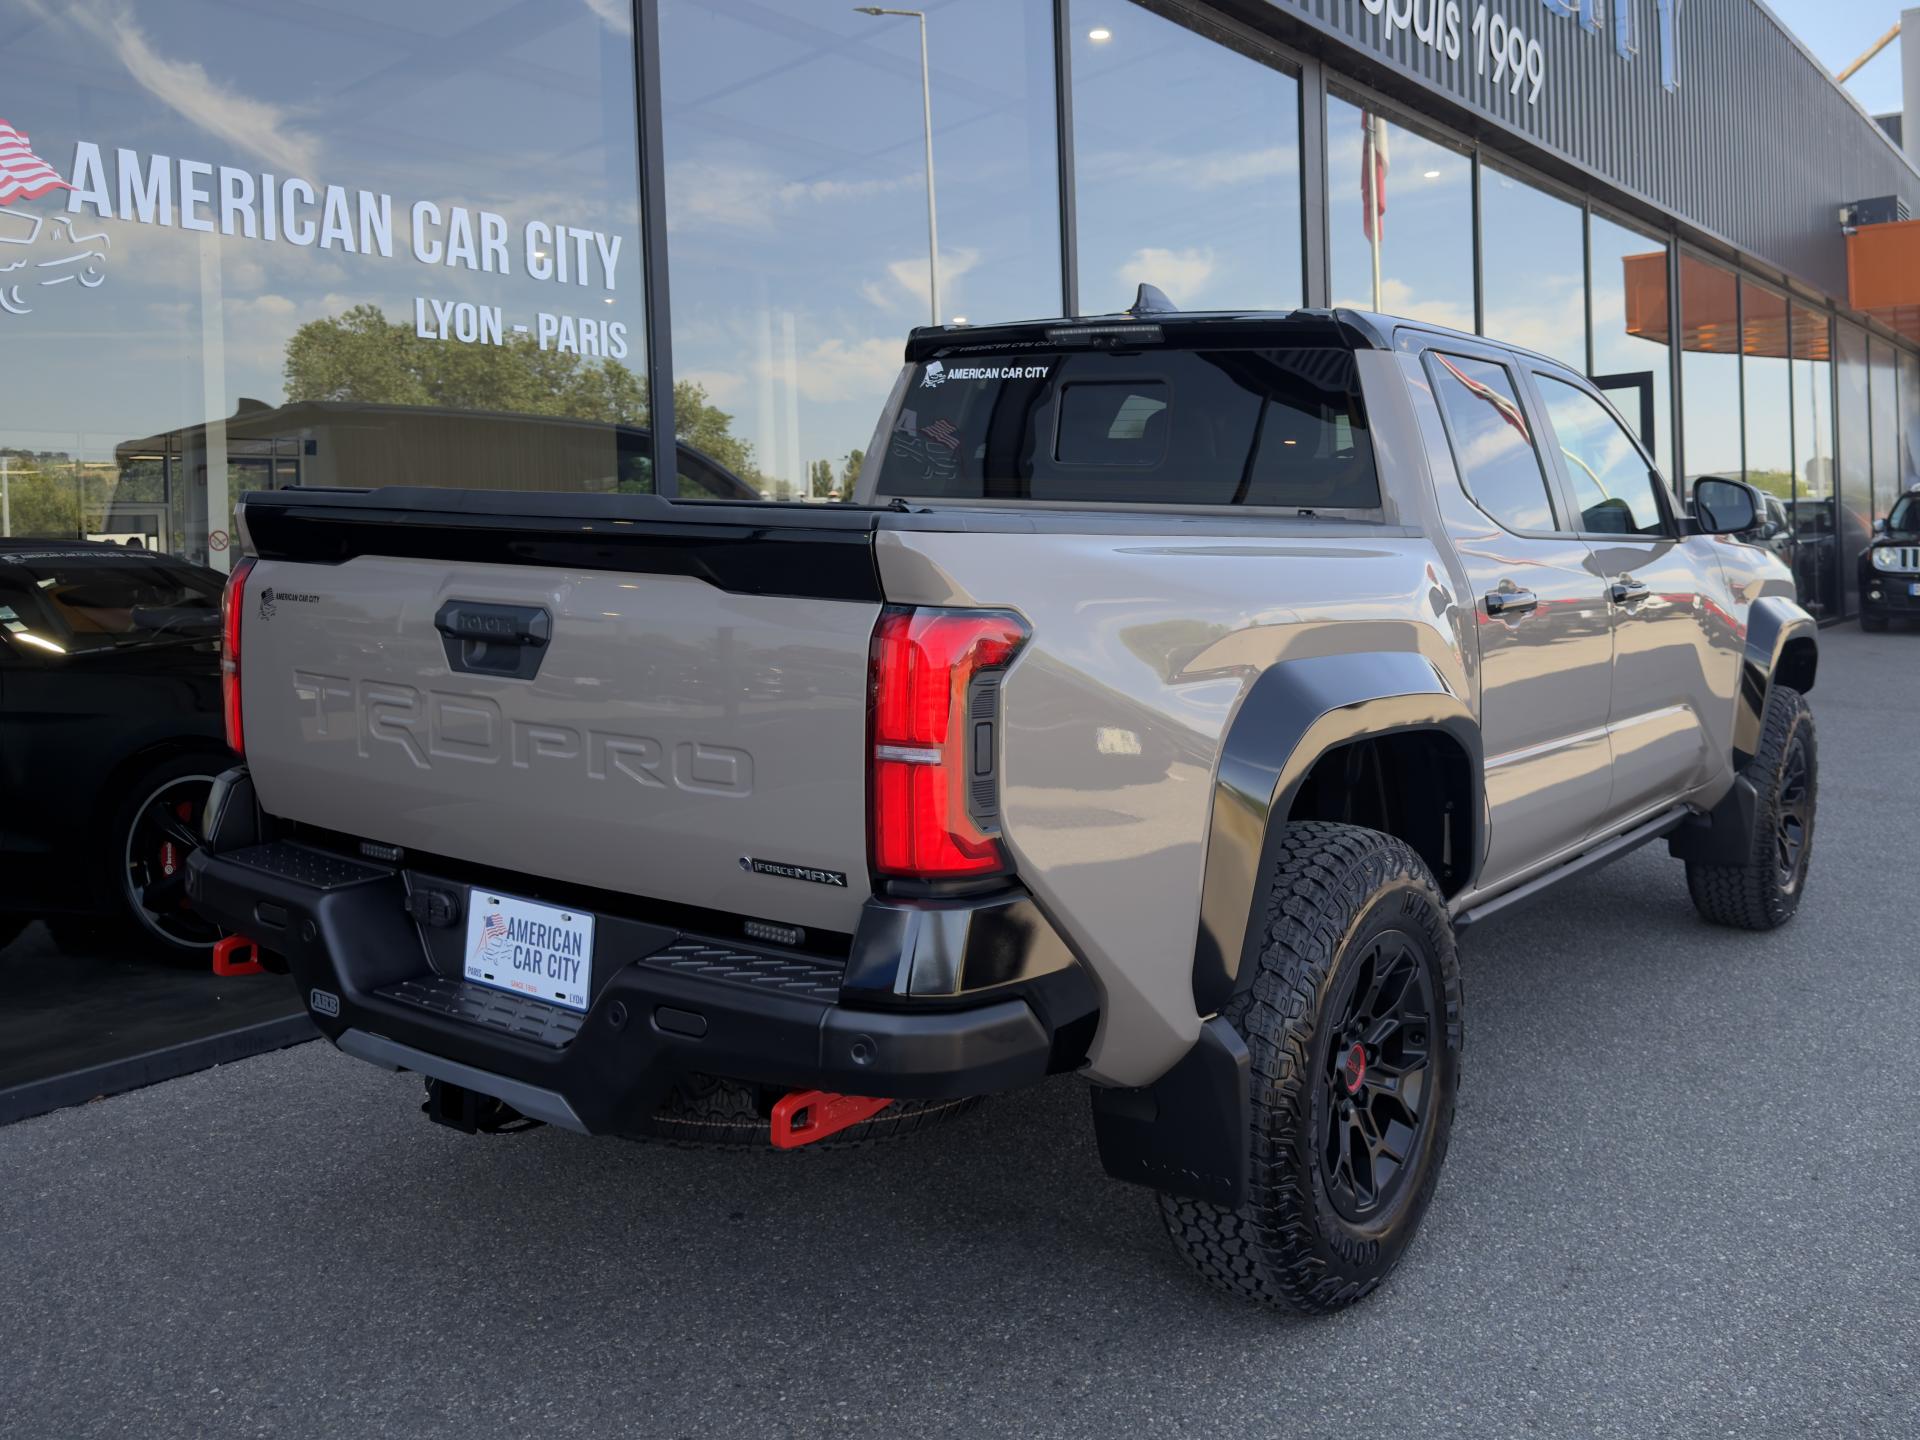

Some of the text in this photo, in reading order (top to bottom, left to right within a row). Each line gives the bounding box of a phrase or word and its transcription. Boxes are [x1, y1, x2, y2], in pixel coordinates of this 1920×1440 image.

[1362, 0, 1460, 61] puis
[1471, 4, 1544, 105] 1999
[67, 141, 622, 290] AMERICAN CAR CITY
[415, 297, 503, 346] LYON
[538, 312, 628, 359] PARIS
[947, 366, 1049, 380] AMERICAN CAR CITY
[506, 916, 582, 958] AMERICAN
[467, 966, 482, 978] PARIS
[513, 945, 580, 984] CAR CITY
[569, 993, 584, 1006] LYON
